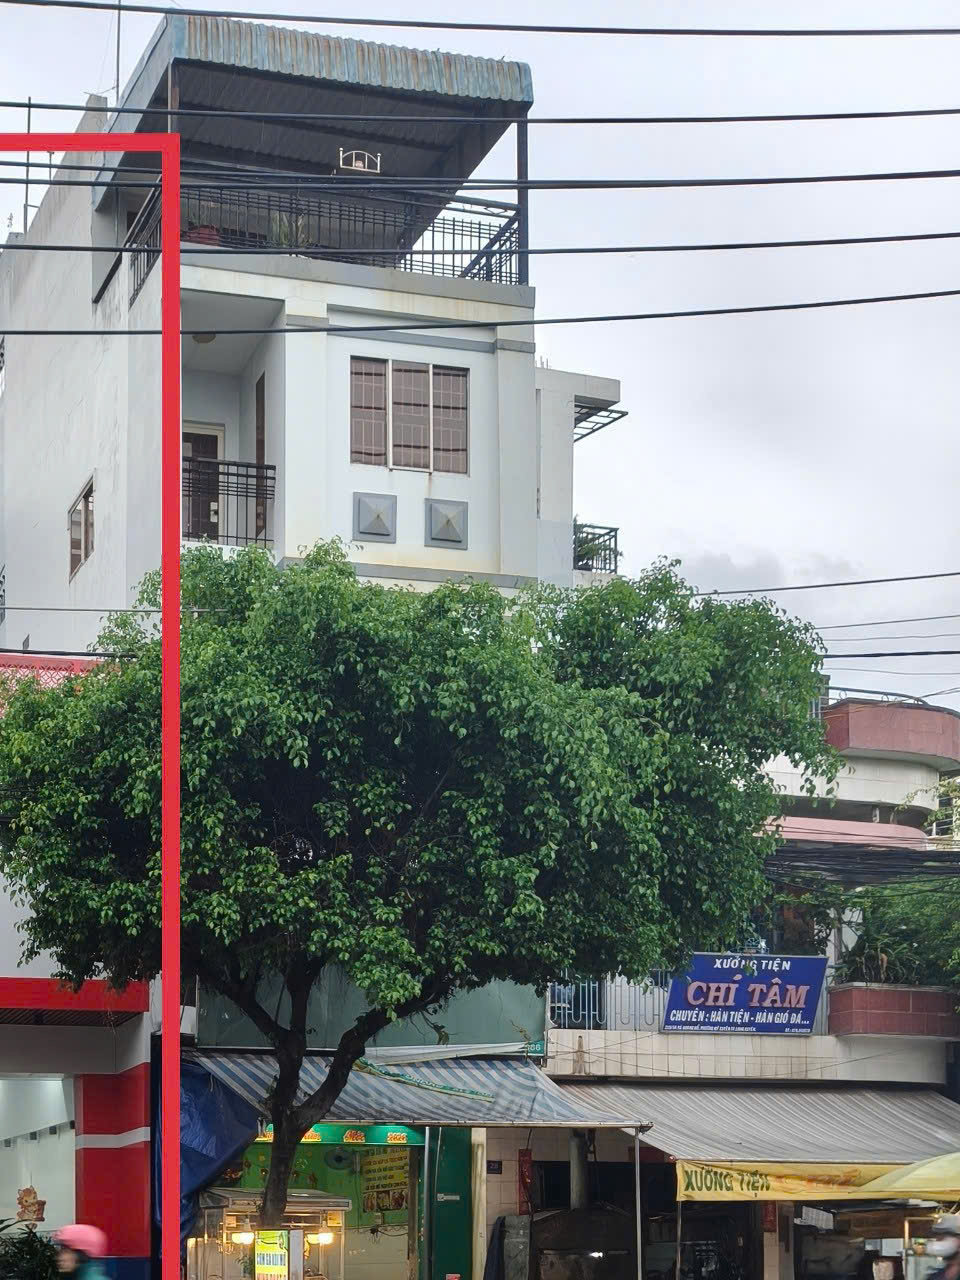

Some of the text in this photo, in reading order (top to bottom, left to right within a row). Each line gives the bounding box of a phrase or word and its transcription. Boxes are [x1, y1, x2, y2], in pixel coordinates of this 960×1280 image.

[761, 958, 791, 972] TIỆN
[687, 974, 810, 1008] CHÍ TÂM
[670, 1008, 704, 1022] CHUYÊN
[711, 1009, 728, 1023] HÀN
[730, 1009, 750, 1024] TIỆN
[755, 1010, 773, 1024] HÀN
[774, 1010, 789, 1024] GIÓ
